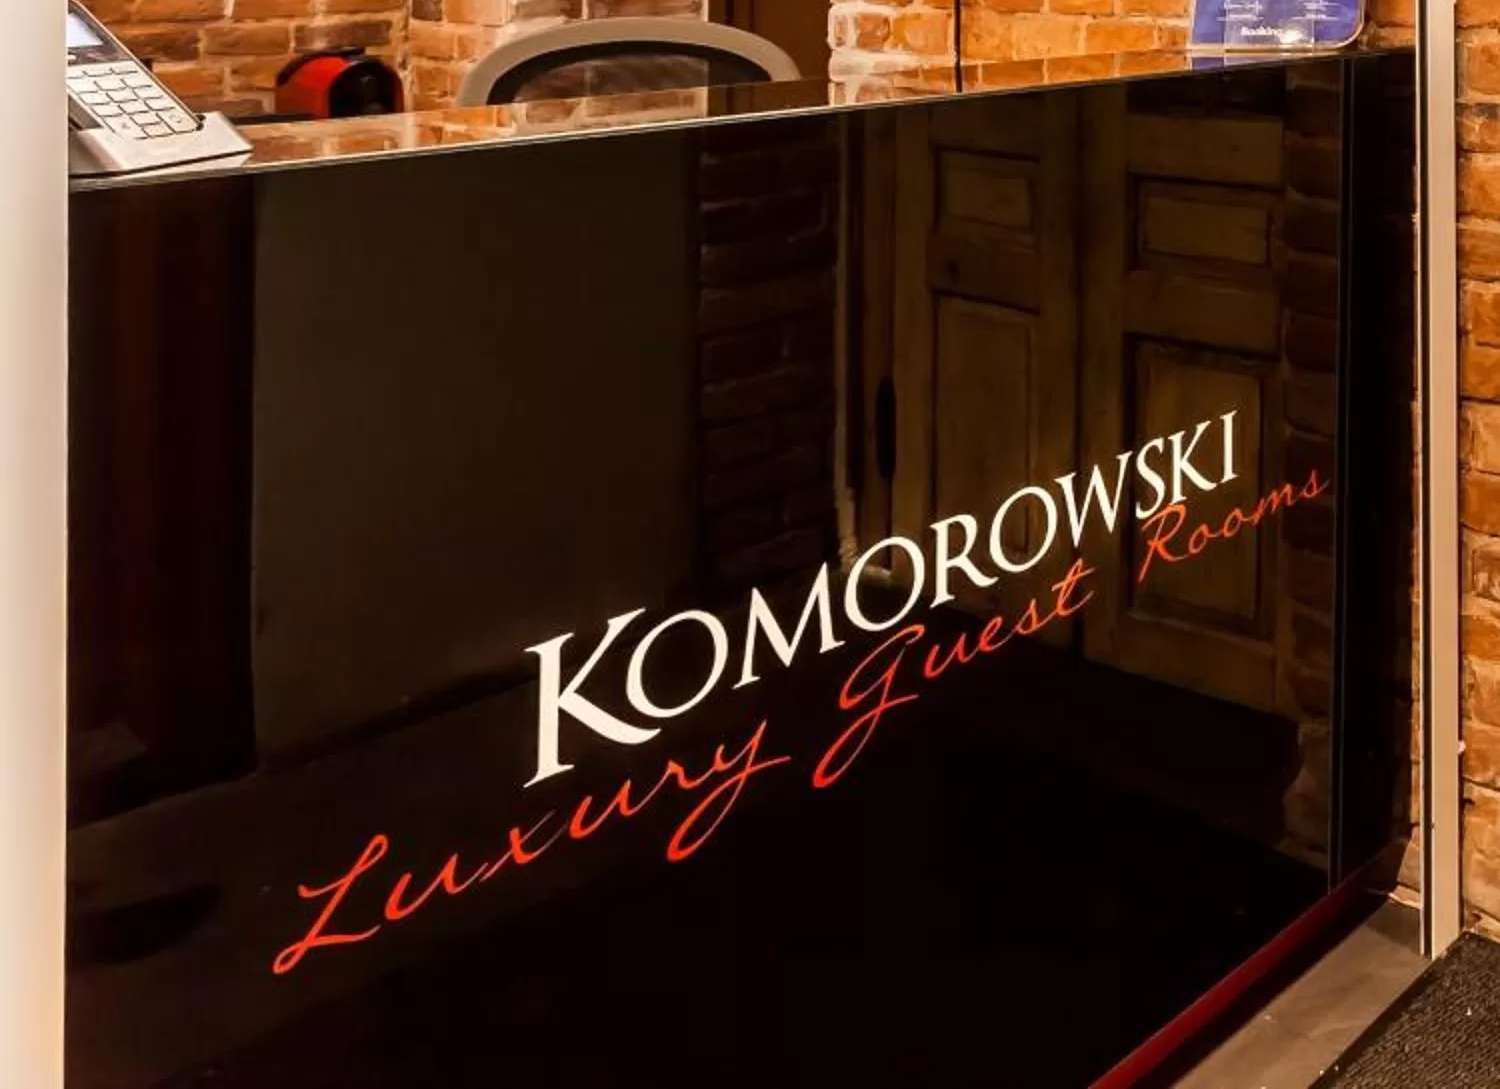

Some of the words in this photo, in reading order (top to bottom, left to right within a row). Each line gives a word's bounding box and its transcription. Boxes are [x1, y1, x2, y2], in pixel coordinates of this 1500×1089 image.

[272, 720, 791, 974] Luxury
[812, 558, 1095, 789] Guest
[1138, 468, 1329, 583] Rooms
[523, 410, 1240, 788] KOMOROWSKI
